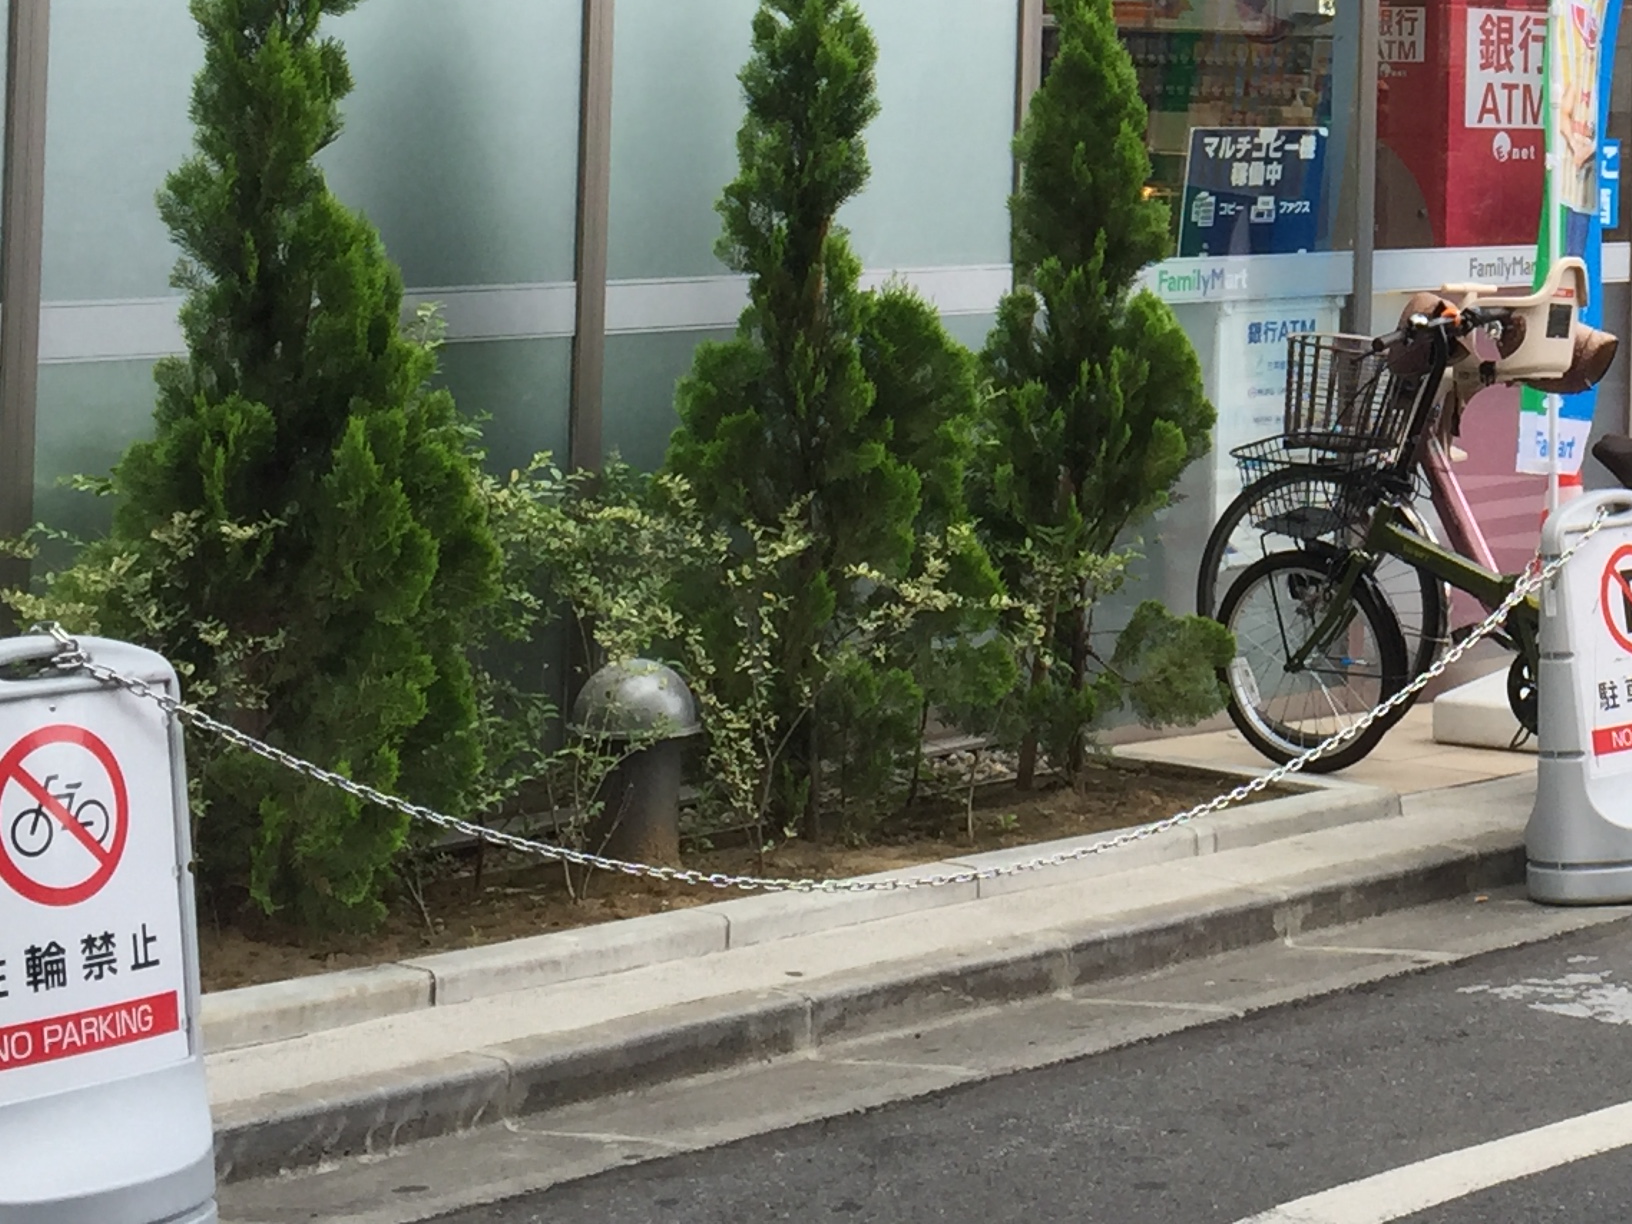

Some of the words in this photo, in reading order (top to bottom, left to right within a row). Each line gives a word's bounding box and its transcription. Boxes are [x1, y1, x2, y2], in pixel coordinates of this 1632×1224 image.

[1479, 13, 1547, 75] 銀行
[1477, 82, 1544, 126] ATM
[1219, 202, 1245, 216] コピー
[1157, 267, 1248, 297] FamilyMart
[1468, 256, 1537, 282] FamilyMar
[1611, 727, 1632, 749] NO
[0, 922, 160, 998] 輪禁止
[43, 1004, 154, 1054] PARKING
